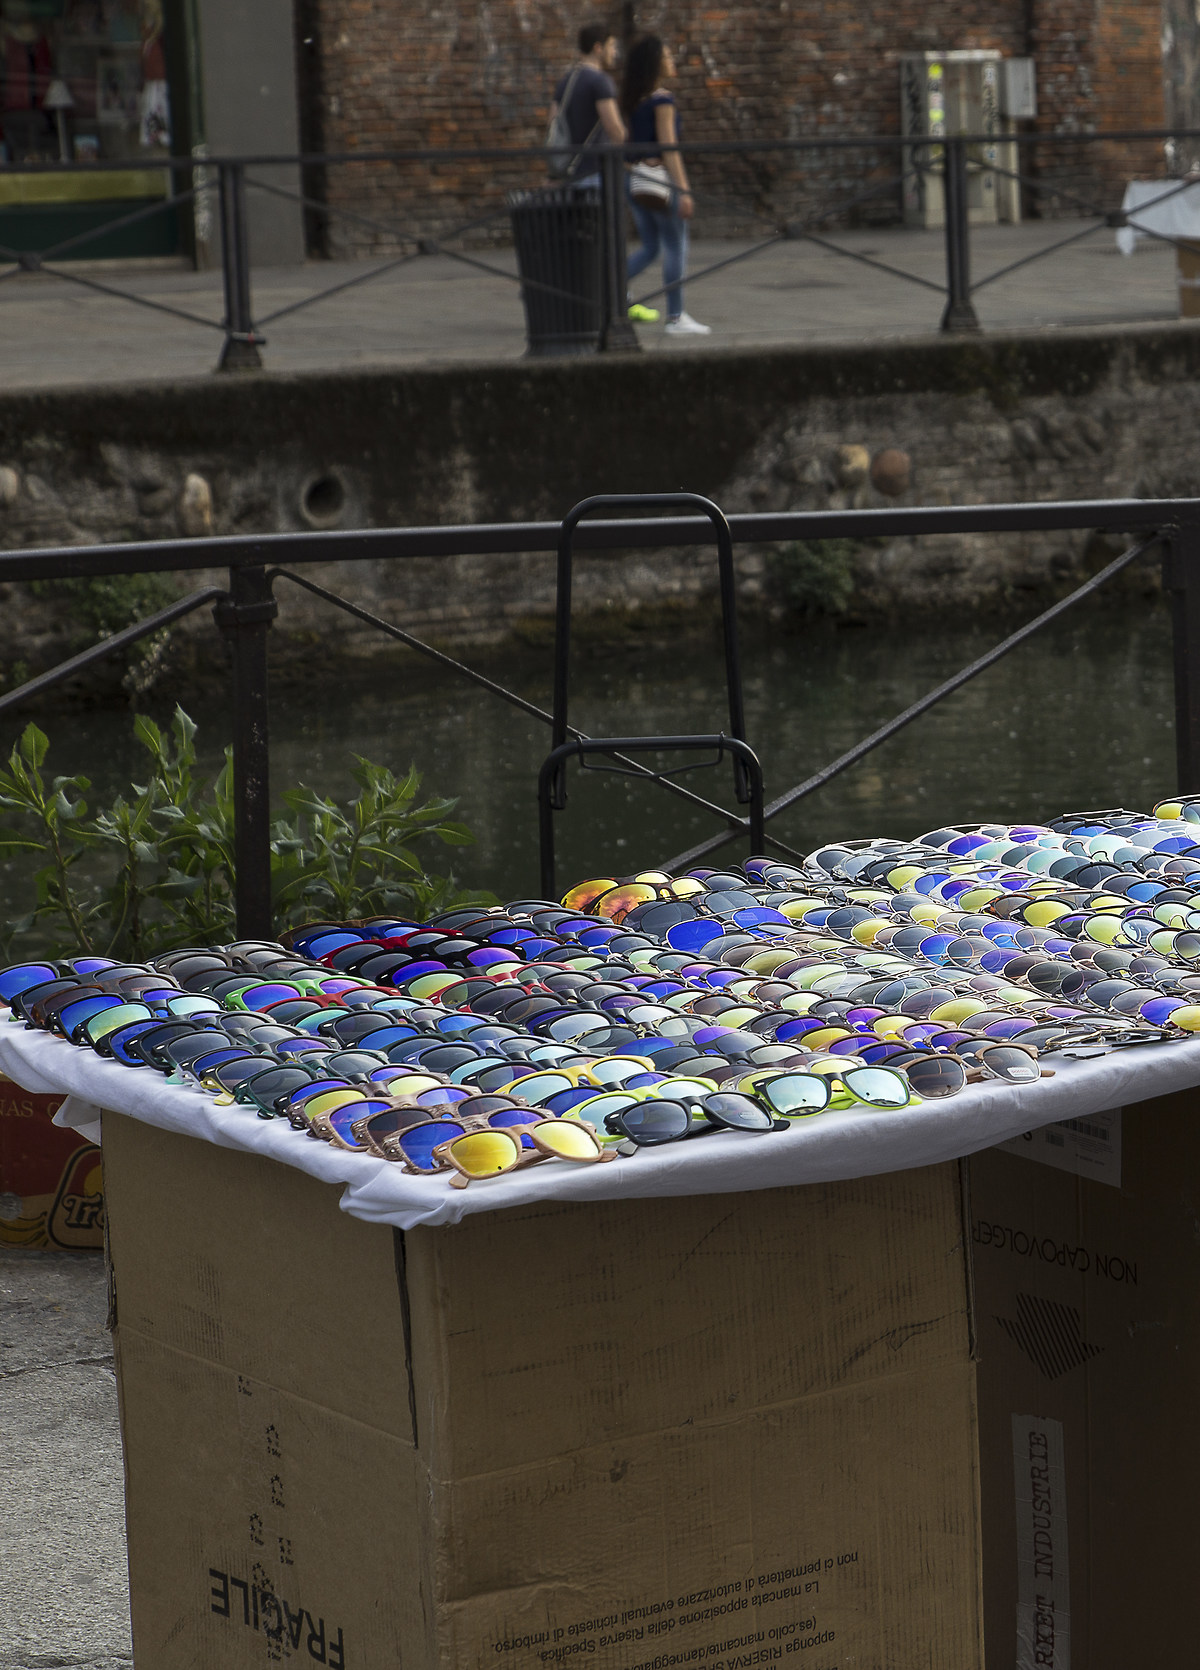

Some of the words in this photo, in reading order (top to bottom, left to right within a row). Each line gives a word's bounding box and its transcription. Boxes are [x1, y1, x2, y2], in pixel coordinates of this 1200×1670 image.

[1096, 1254, 1138, 1286] NON
[1028, 1431, 1054, 1580] INDUSTRIE
[824, 1558, 834, 1572] ci
[837, 1551, 858, 1565] non
[746, 1578, 755, 1592] di
[758, 1563, 821, 1586] permetterà
[678, 1583, 741, 1604] autorizzare
[752, 1586, 801, 1606] mancata
[805, 1580, 819, 1593] La
[208, 1568, 345, 1668] FRAGILE
[621, 1598, 674, 1621] eventuali
[678, 1597, 748, 1627] apposizione
[553, 1629, 565, 1643] di
[568, 1614, 618, 1636] richieste
[647, 1618, 675, 1635] della
[768, 1616, 817, 1639] (es.collo
[491, 1631, 549, 1653] rimborso.
[599, 1626, 644, 1647] Riserva
[786, 1631, 836, 1652] apponga
[536, 1638, 596, 1663] Specifica,
[728, 1646, 782, 1670] RISERVA
